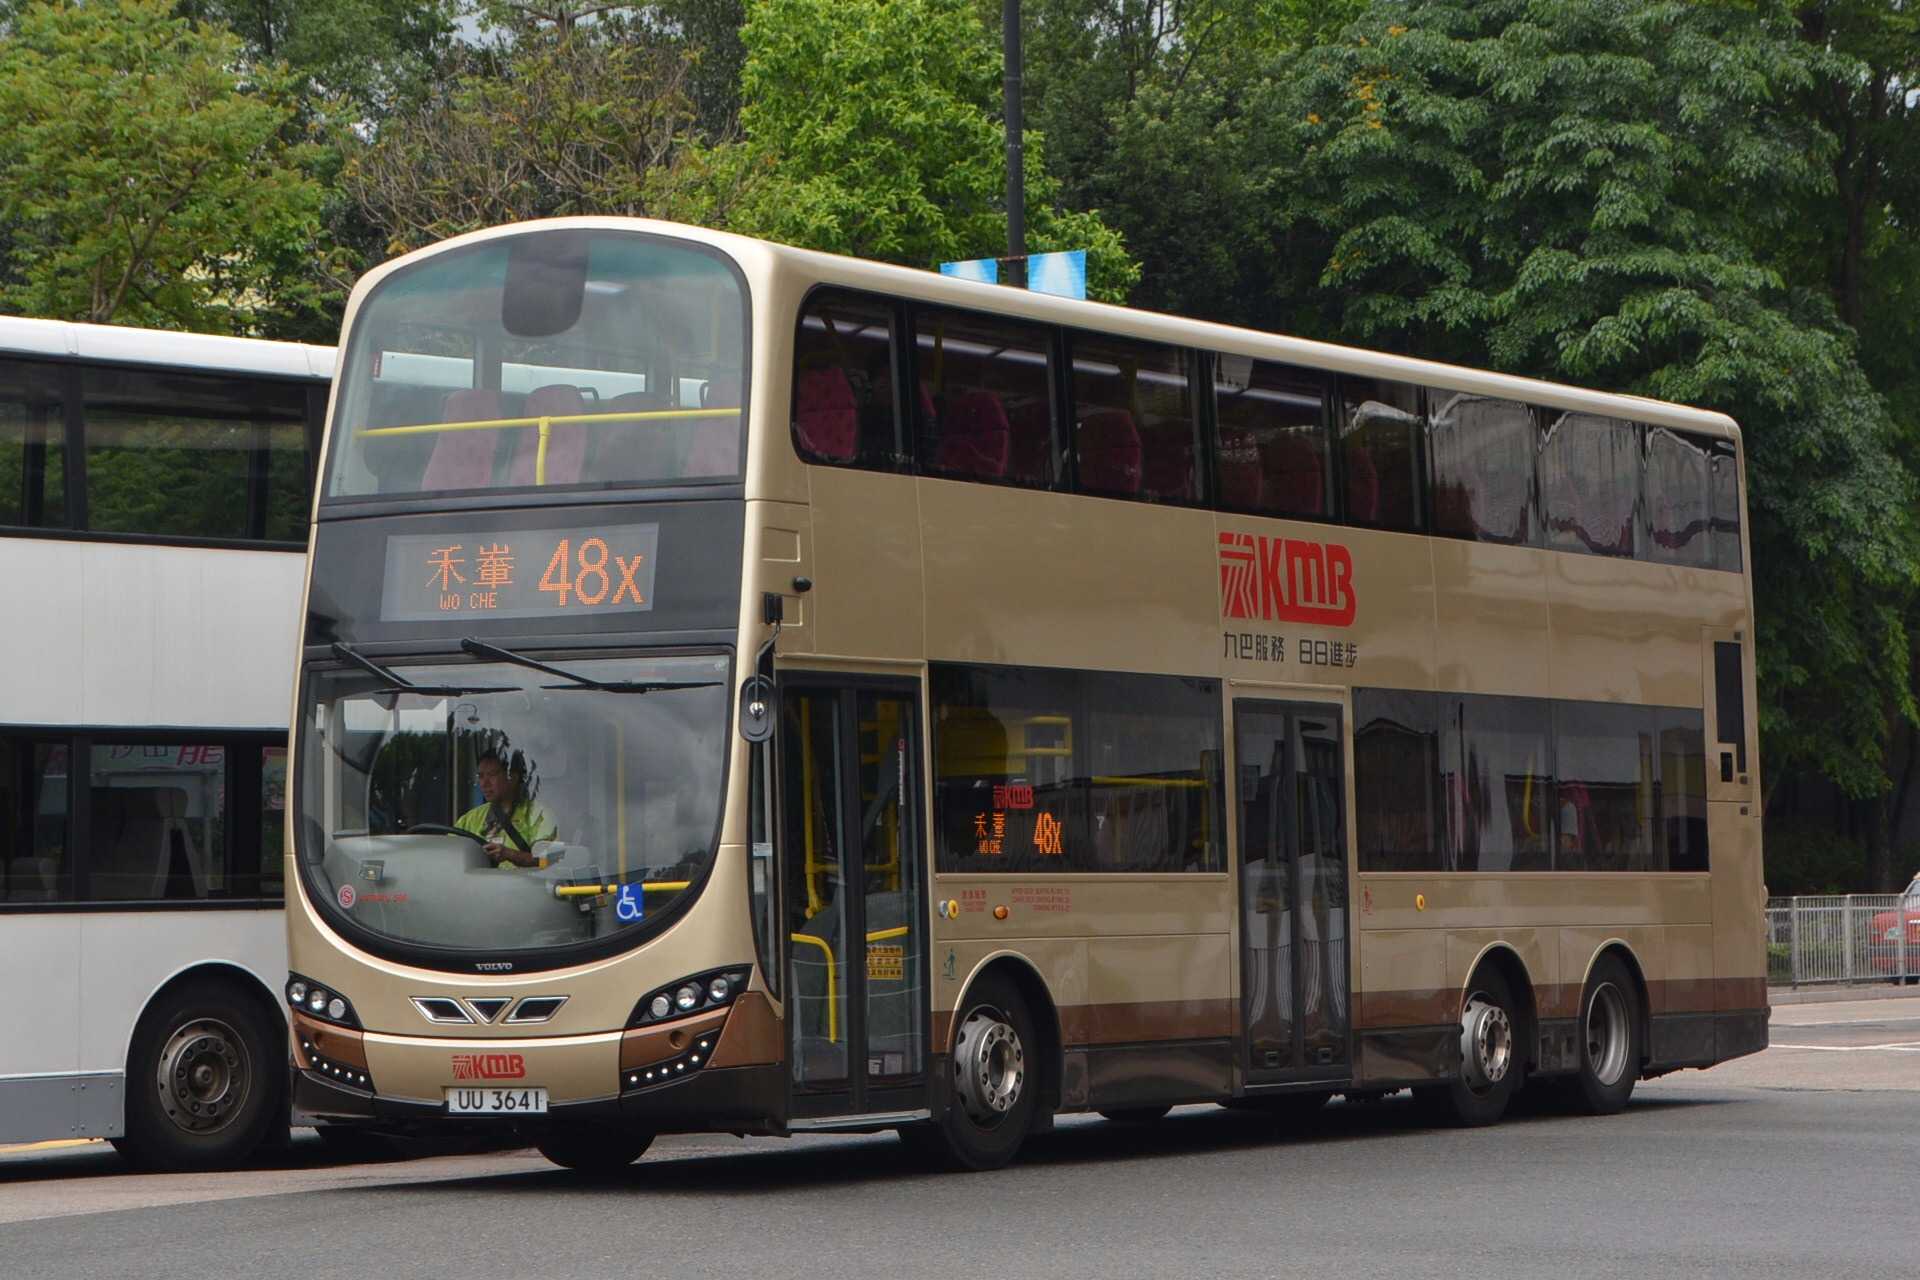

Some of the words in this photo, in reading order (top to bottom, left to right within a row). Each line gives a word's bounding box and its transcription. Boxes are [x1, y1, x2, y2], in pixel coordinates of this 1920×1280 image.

[425, 543, 514, 591] 禾輋
[1258, 535, 1356, 627] KMB
[440, 593, 459, 609] WO
[469, 592, 497, 608] CHE
[1223, 631, 1285, 662] 九巴服務
[1299, 639, 1357, 668] 日日進步
[475, 962, 513, 971] VOLVO
[473, 1054, 526, 1079] KMB
[458, 1091, 484, 1110] UU
[491, 1091, 541, 1110] 3641
